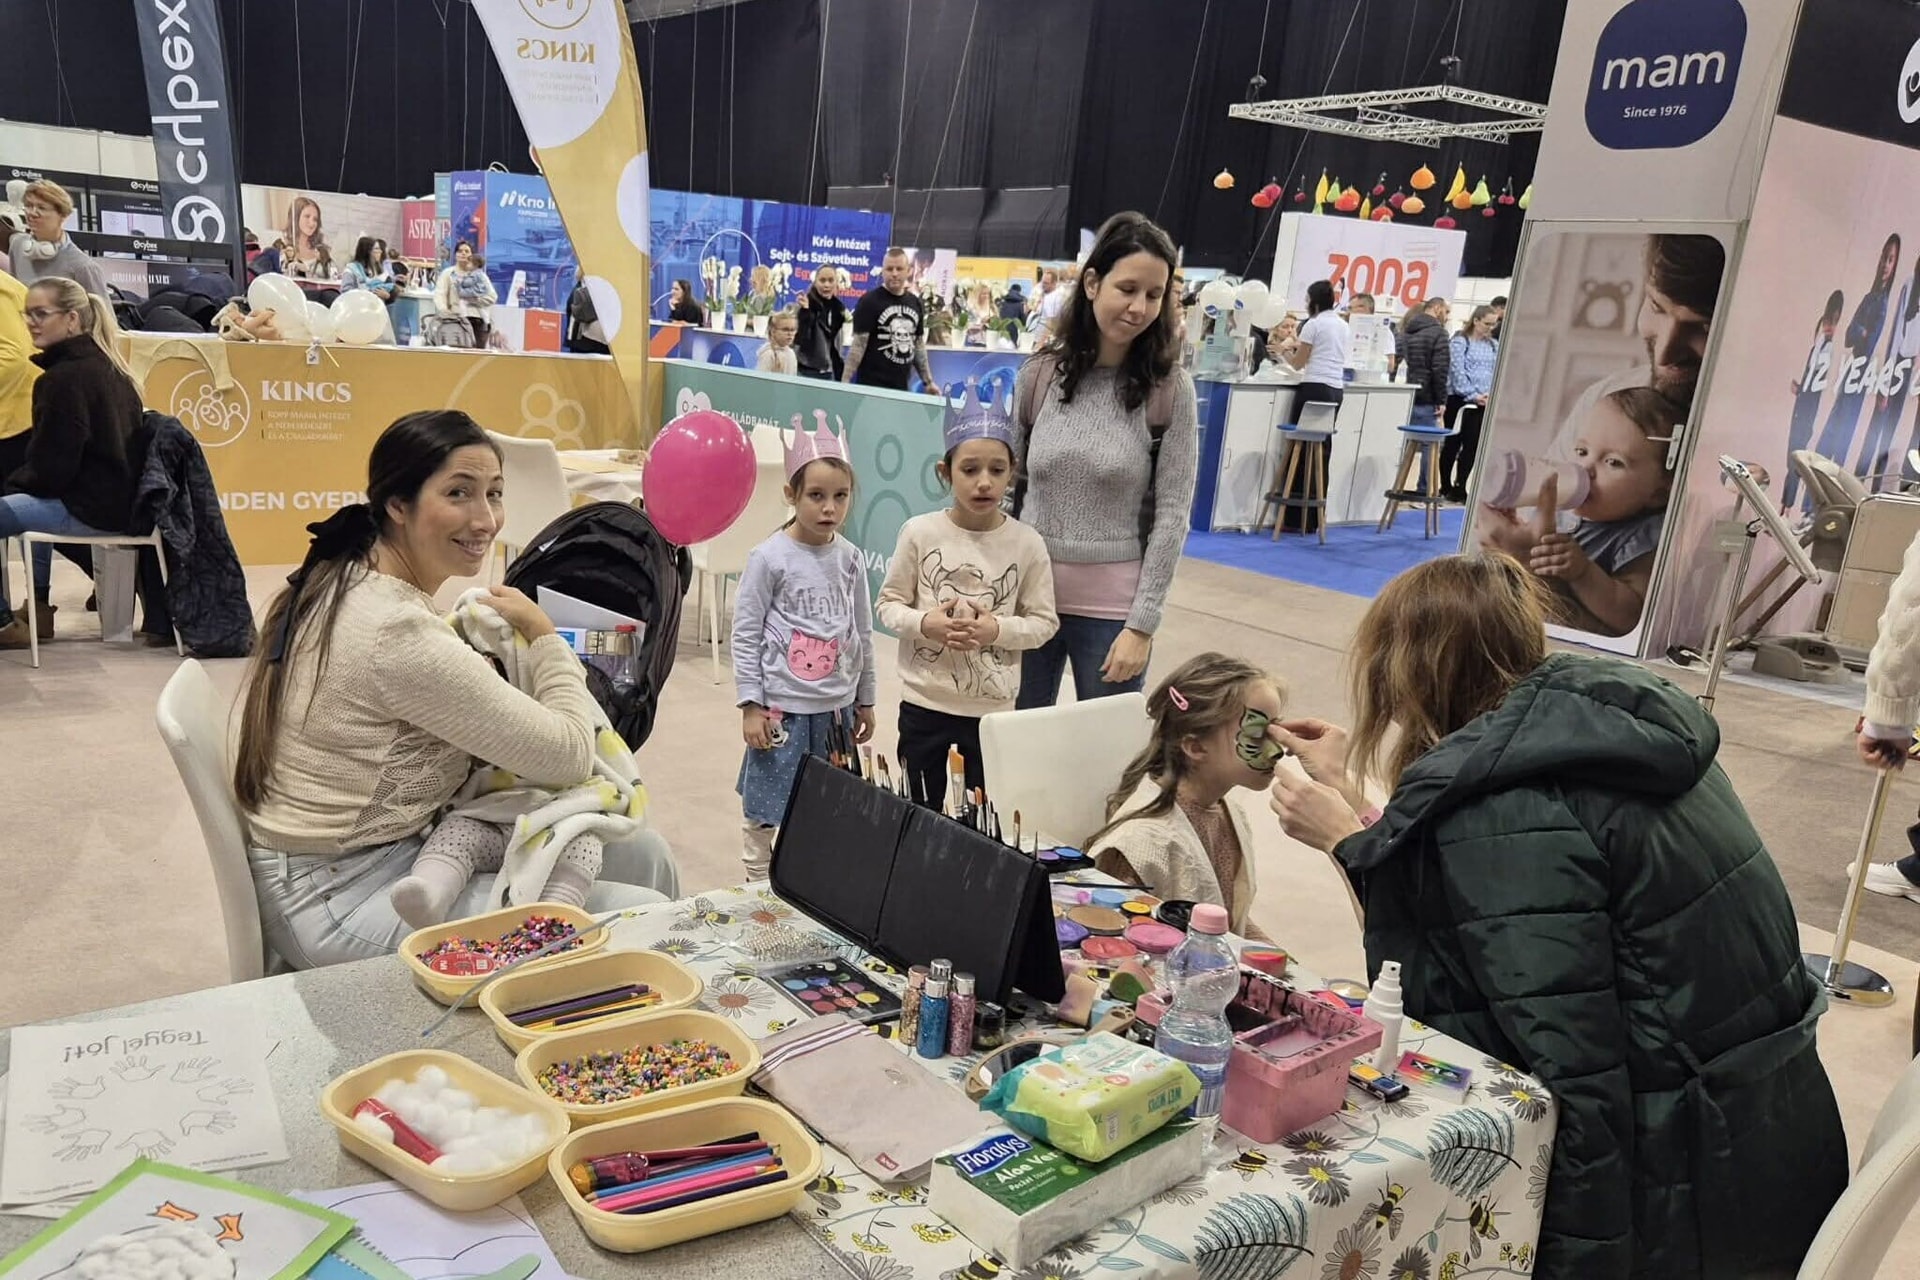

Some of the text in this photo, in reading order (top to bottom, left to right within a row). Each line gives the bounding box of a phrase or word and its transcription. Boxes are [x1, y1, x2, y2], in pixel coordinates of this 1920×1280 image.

[1602, 51, 1726, 90] mam
[1623, 105, 1687, 118] Since 1976
[770, 249, 869, 267] Sejt- és Szövetbank
[812, 236, 871, 251] Krio Intézet
[1802, 341, 1832, 392] 12
[1834, 354, 1912, 397] YEARS
[262, 380, 352, 403] KINCS
[63, 1029, 208, 1063] Tegyél jót!
[956, 1137, 1026, 1173] Floralys
[994, 1151, 1059, 1184] Aloe Ver
